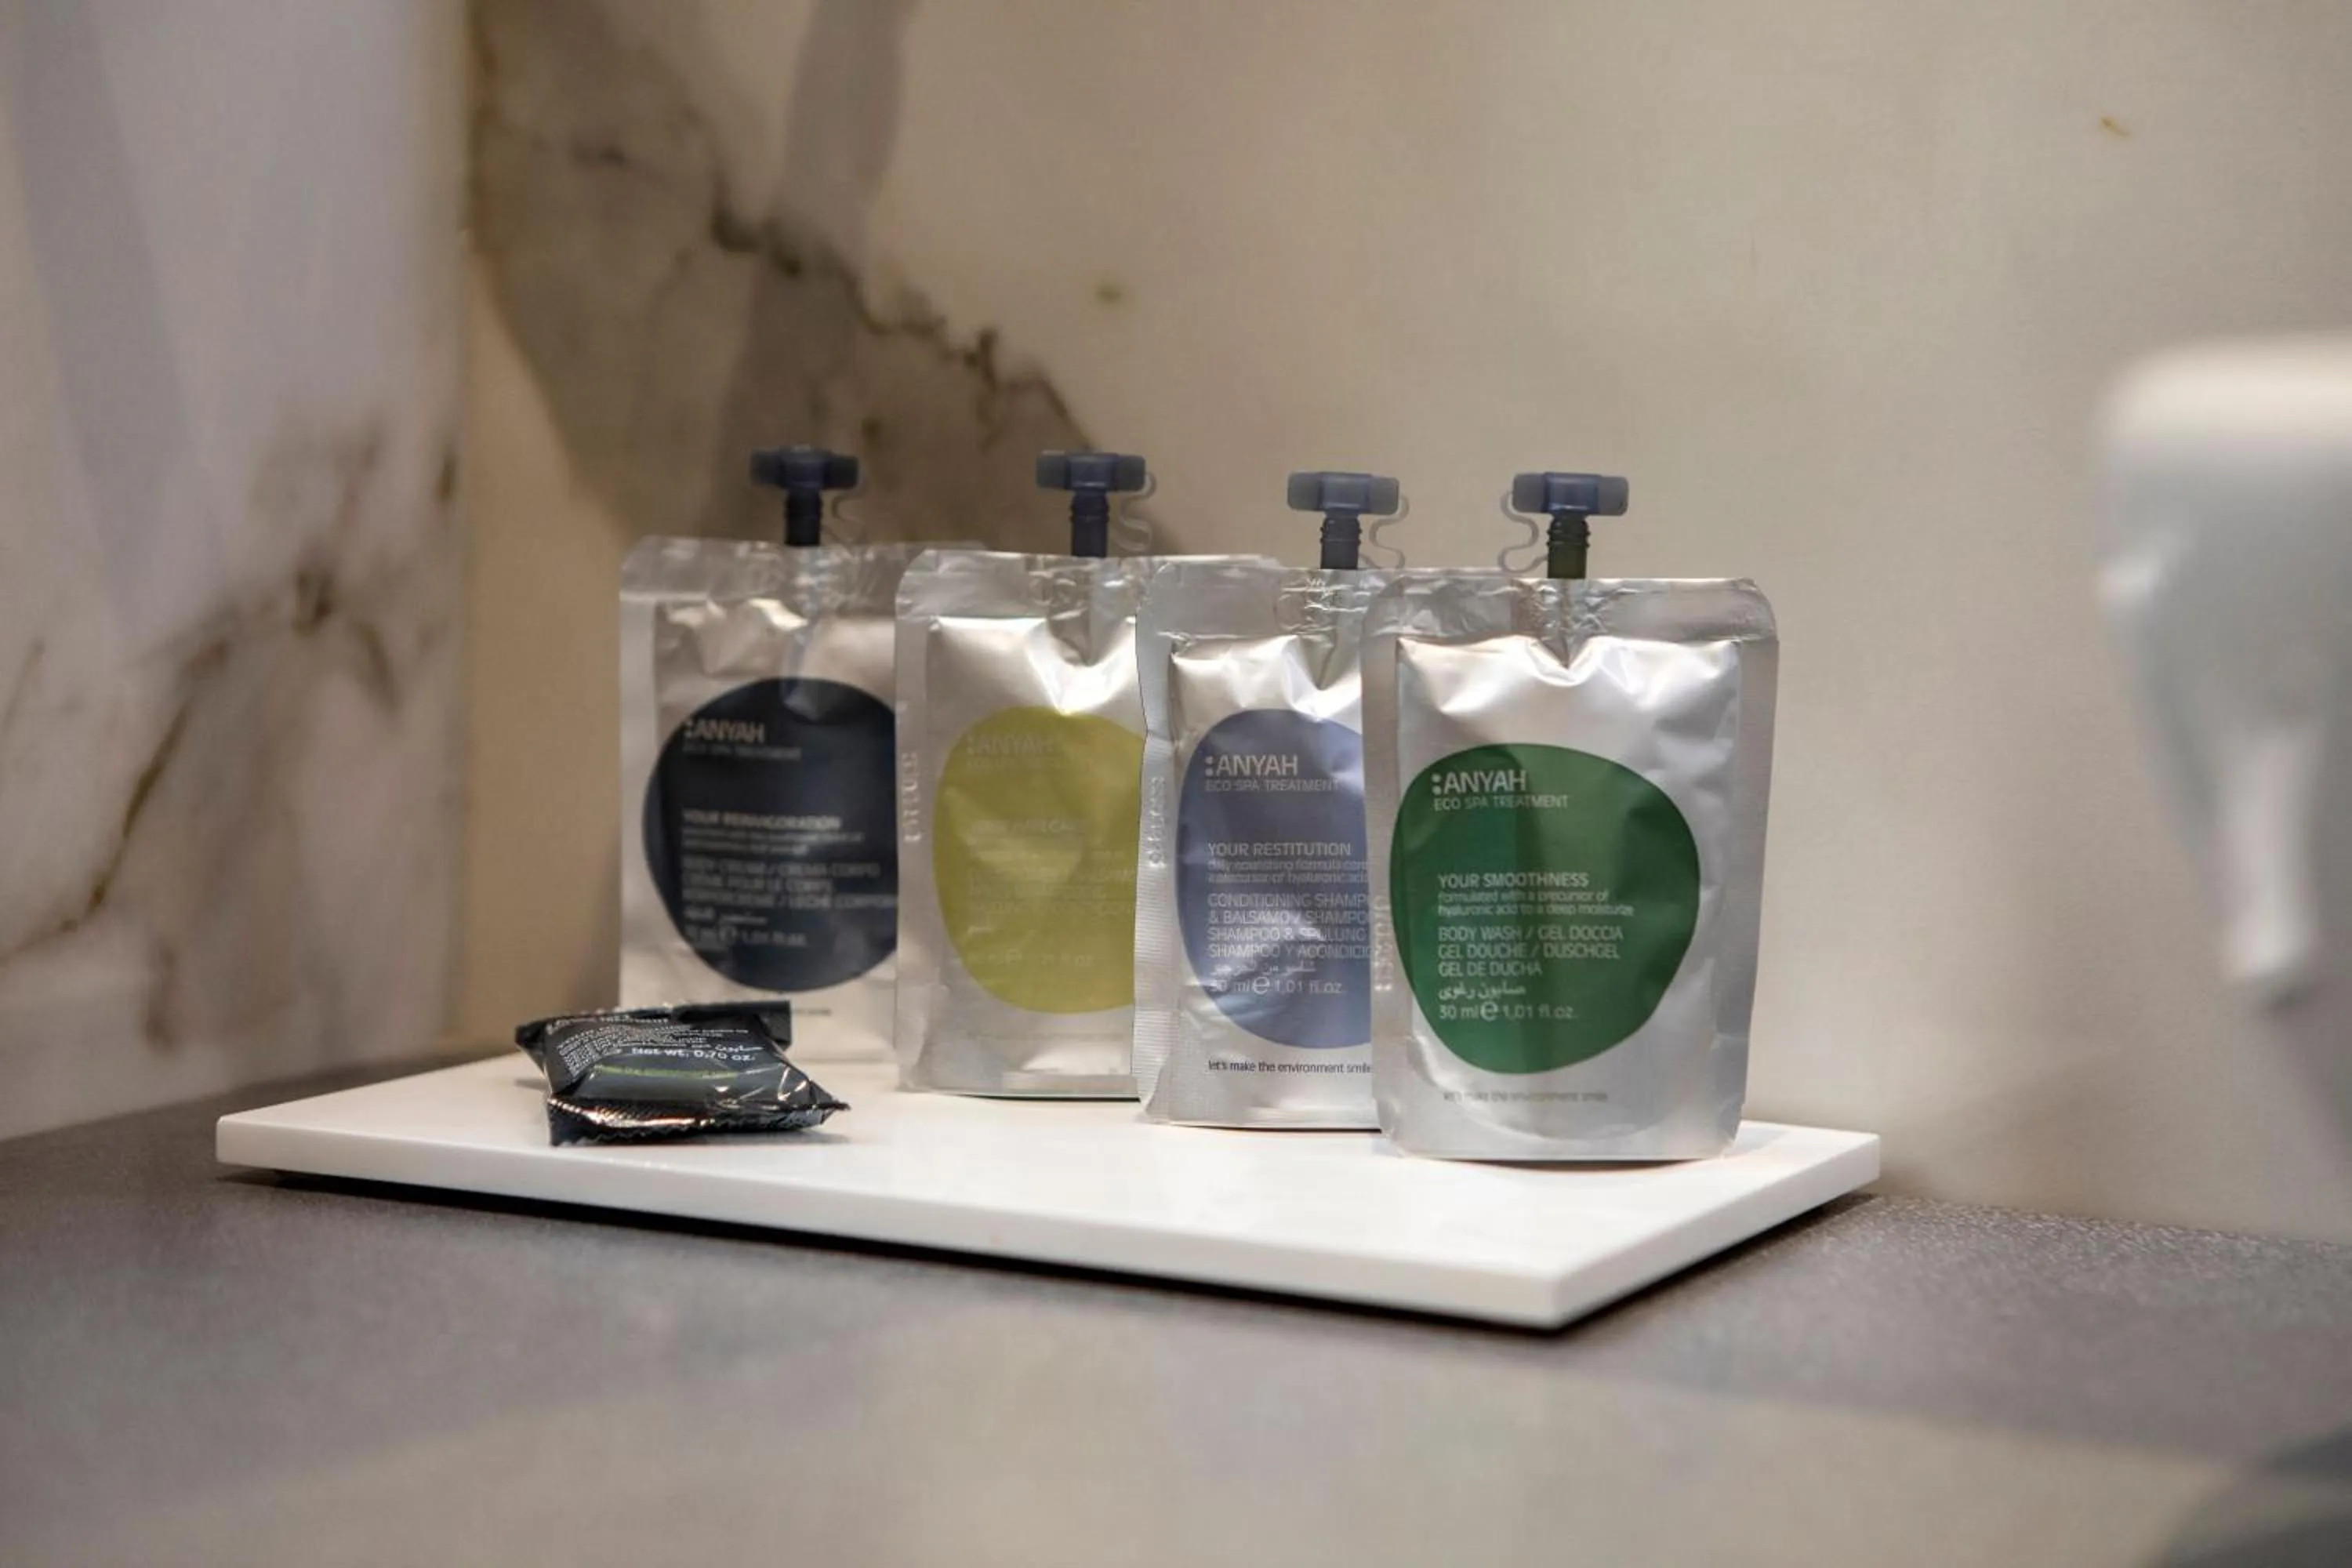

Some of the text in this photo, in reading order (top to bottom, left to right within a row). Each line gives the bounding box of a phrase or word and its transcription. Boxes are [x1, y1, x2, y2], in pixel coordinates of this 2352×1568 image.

[1205, 753, 1298, 776] :ANYAH
[1206, 779, 1339, 792] ECO SPA TREATMENT
[1431, 769, 1527, 795] :ANYAH
[1434, 793, 1569, 811] ECO SPA TREATMENT
[1207, 842, 1352, 857] YOUR RESTITUTION
[1438, 872, 1590, 888] YOUR SMOOTHNESS
[1207, 892, 1312, 907] CONDITIONING
[1595, 888, 1610, 902] of
[1223, 909, 1290, 924] BALSAMO
[1207, 927, 1280, 942] SHAMPOO
[1439, 926, 1475, 941] BODY
[1480, 926, 1522, 941] WASH
[1537, 925, 1566, 940] GEL
[1569, 925, 1624, 940] DOCCIA
[1208, 943, 1281, 957] SHAMPOO
[1438, 944, 1463, 959] GEL
[1467, 944, 1528, 958] DOUCHE
[1543, 942, 1620, 960] DUSCHGEL
[1438, 960, 1543, 977] GEL DE DUCHA
[1439, 1004, 1457, 1019] 30
[1461, 1004, 1479, 1018] ml
[1503, 1004, 1534, 1018] 1.01
[631, 1047, 660, 1055] Net
[693, 1049, 728, 1060] 0.70
[1208, 1060, 1227, 1071] let's
[1229, 1061, 1256, 1072] make
[1258, 1061, 1276, 1072] the
[1277, 1062, 1344, 1073] environment
